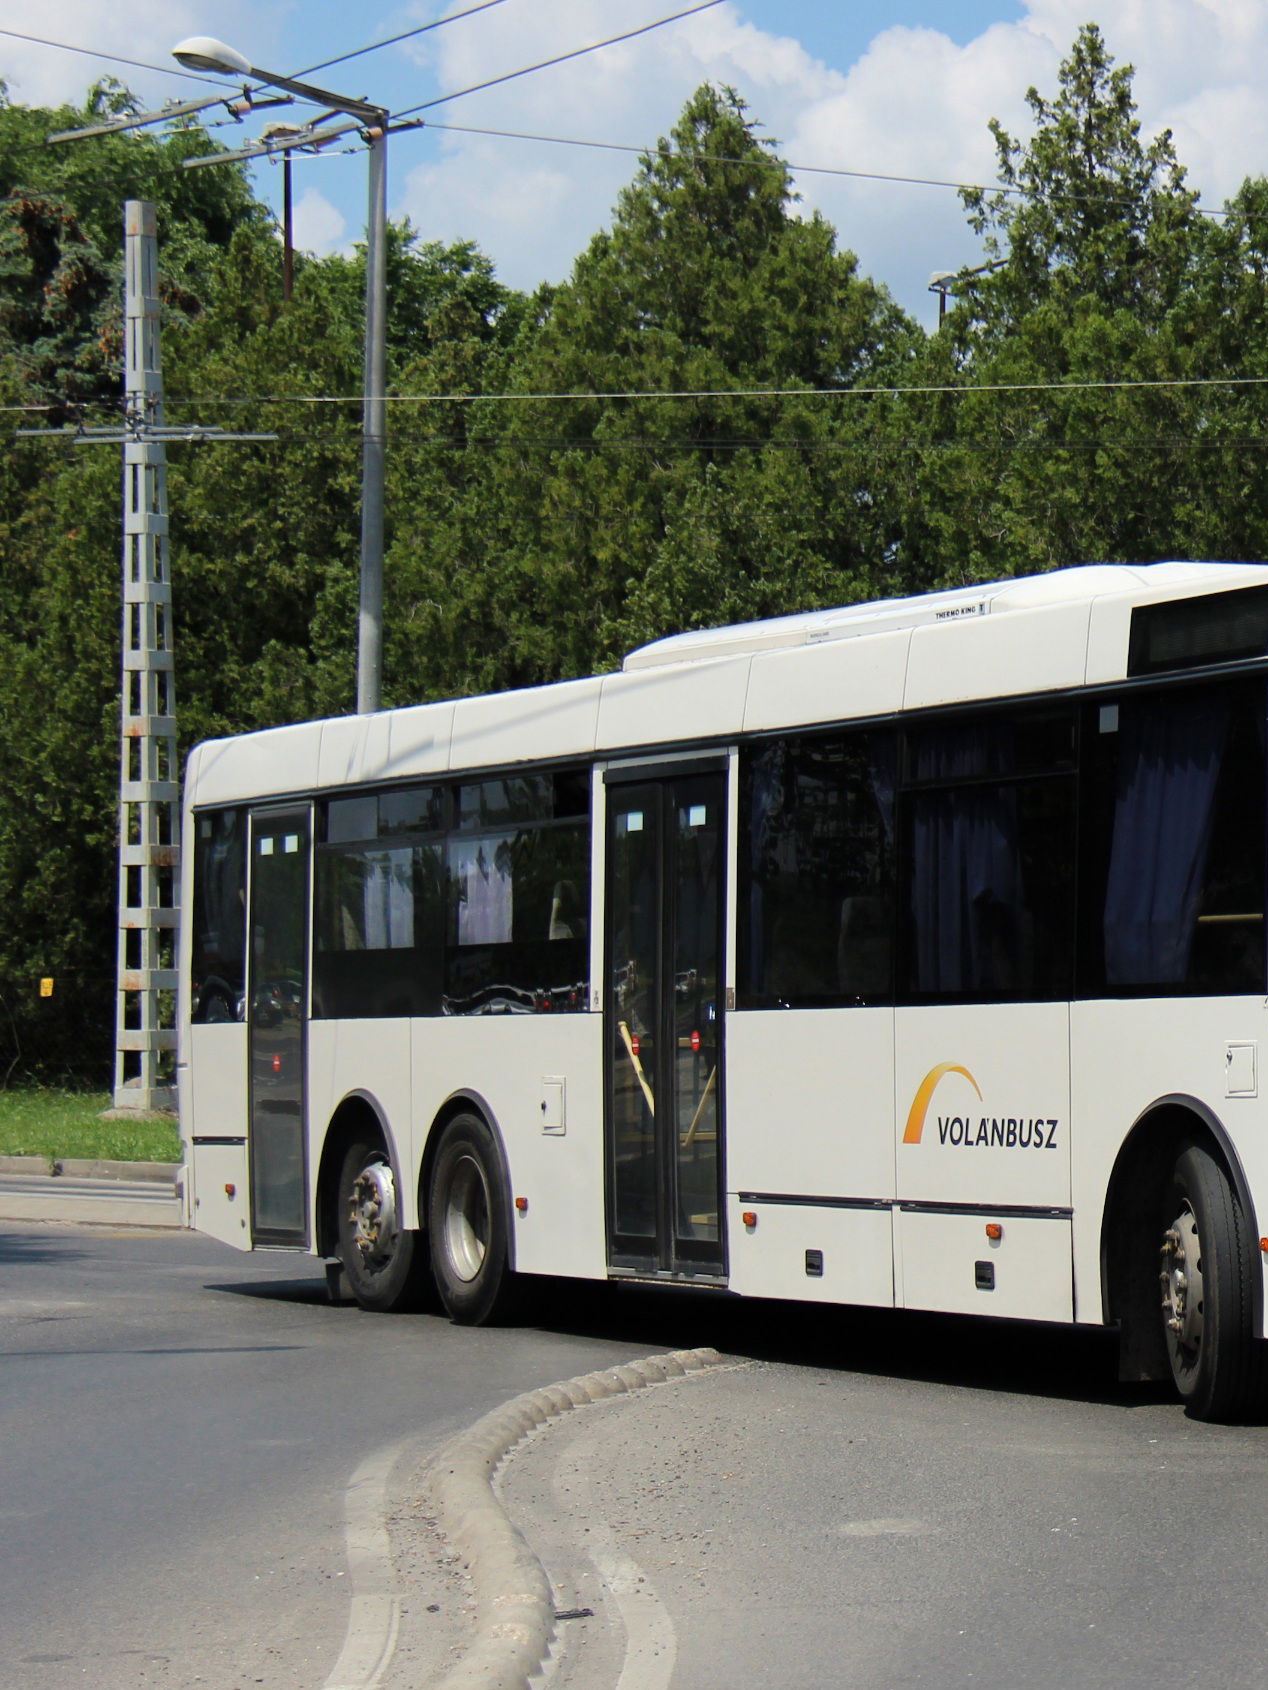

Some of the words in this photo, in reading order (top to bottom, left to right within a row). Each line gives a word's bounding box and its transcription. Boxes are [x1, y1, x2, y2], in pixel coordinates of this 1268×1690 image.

[936, 609, 960, 619] THERMO
[961, 606, 976, 615] KING
[937, 1116, 1059, 1149] VOLÁNBUSZ
